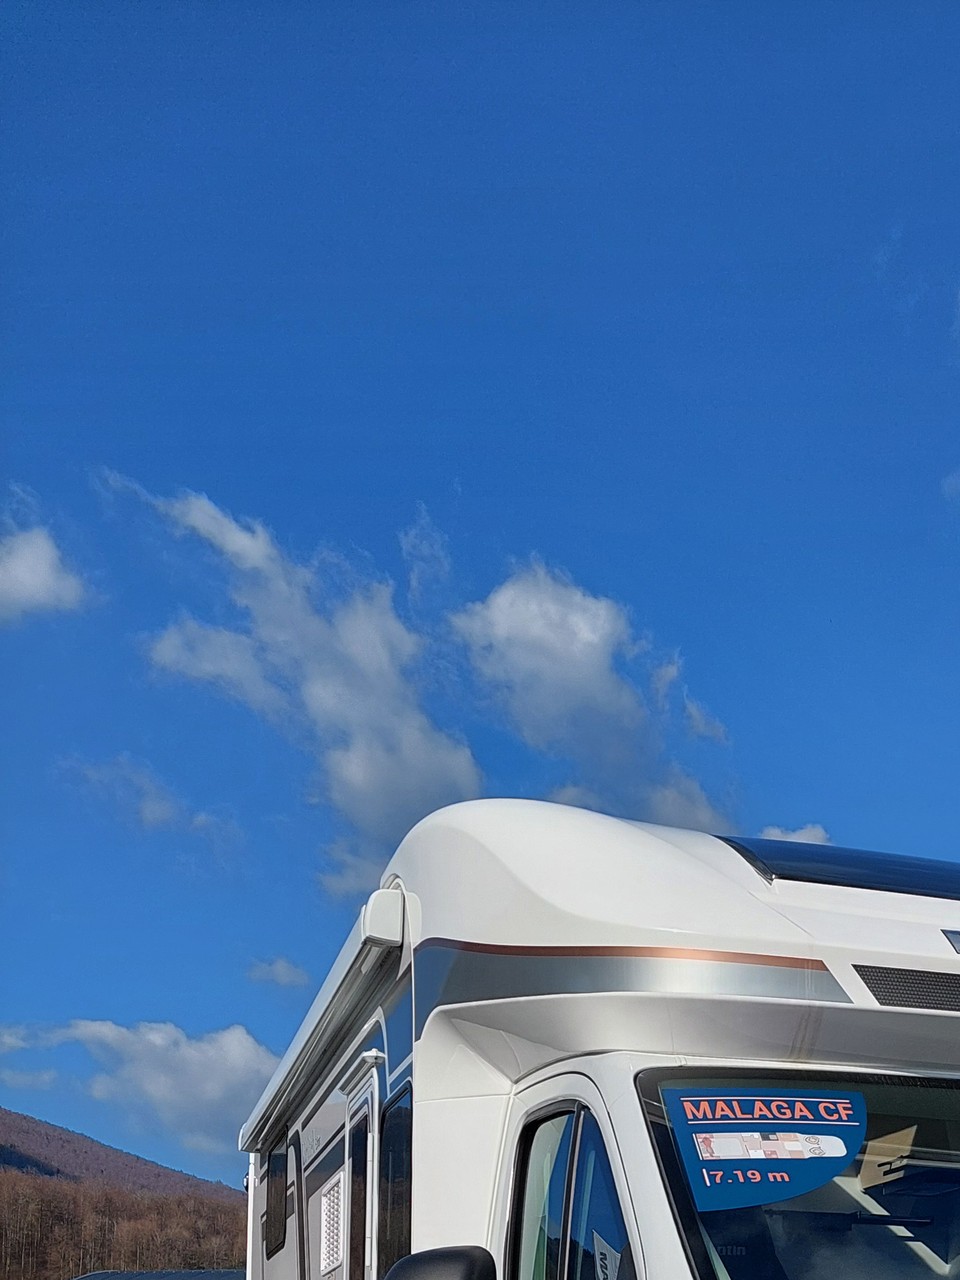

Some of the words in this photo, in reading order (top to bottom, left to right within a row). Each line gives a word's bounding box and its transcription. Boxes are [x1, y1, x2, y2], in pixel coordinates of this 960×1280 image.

[683, 1100, 814, 1120] MALAGA
[818, 1102, 853, 1121] CF
[710, 1170, 761, 1184] 7.19
[768, 1171, 790, 1182] m
[717, 1245, 746, 1256] otin
